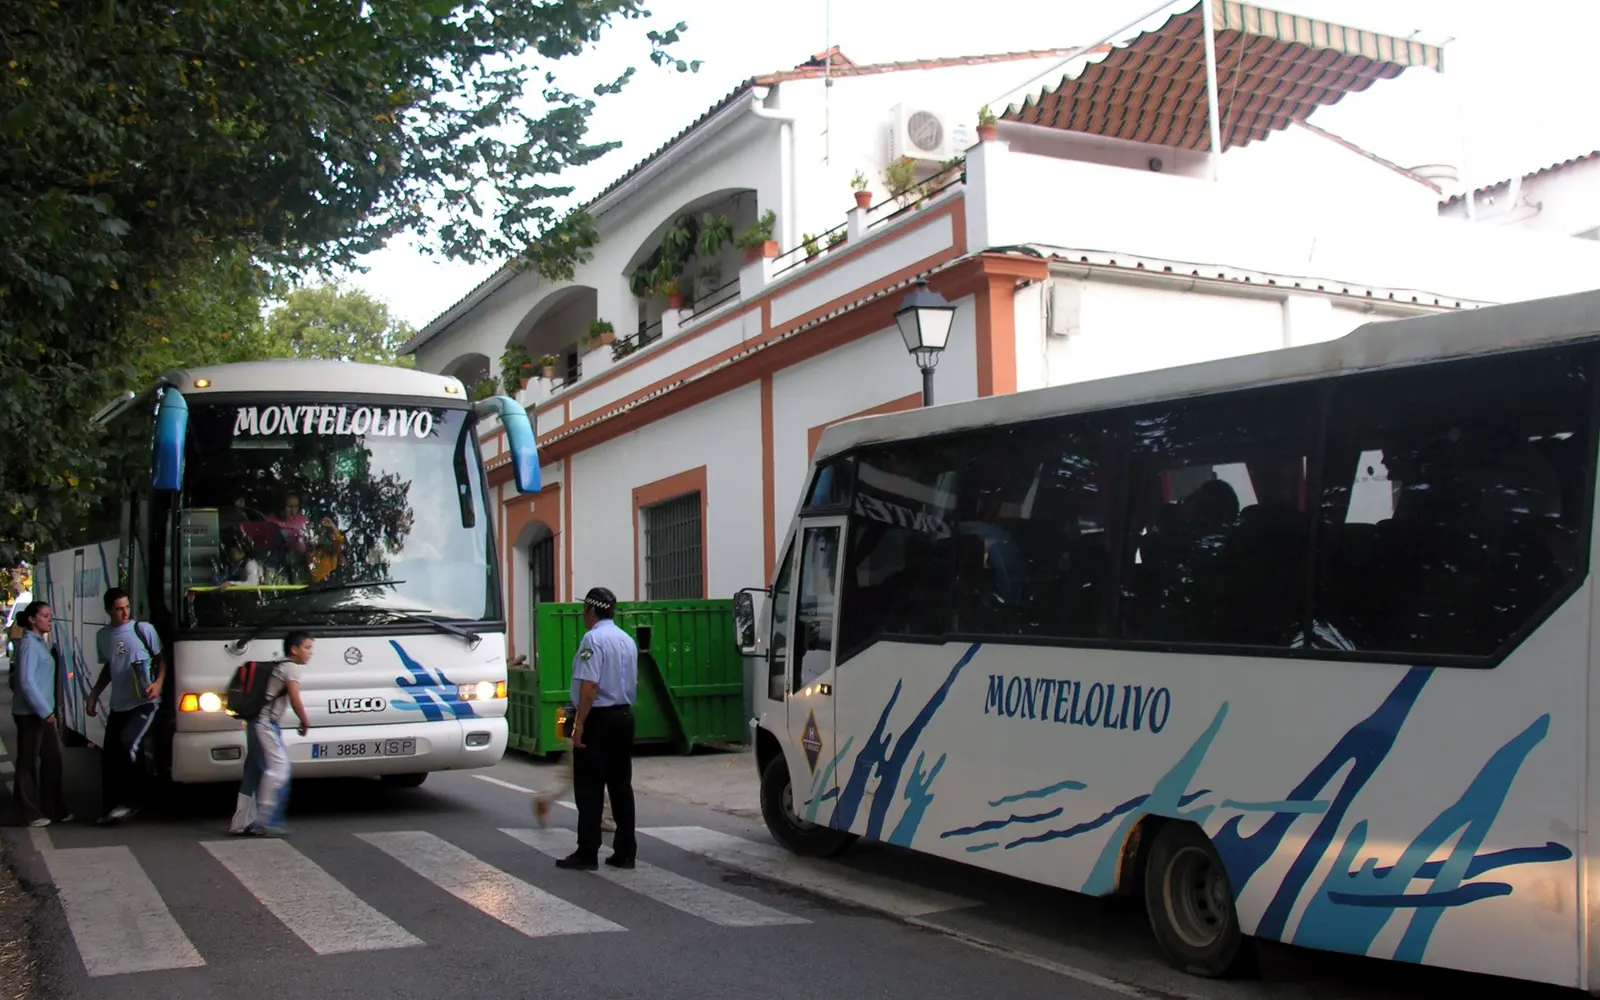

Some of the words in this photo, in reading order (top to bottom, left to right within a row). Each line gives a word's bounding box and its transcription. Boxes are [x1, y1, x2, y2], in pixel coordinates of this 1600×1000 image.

[233, 405, 433, 439] MONTELOLIVO
[328, 697, 386, 714] IVECO
[984, 674, 1171, 734] MONTELOLIVO
[320, 745, 328, 757] H
[337, 743, 366, 756] 3858
[374, 742, 382, 754] X
[389, 741, 412, 754] SP
